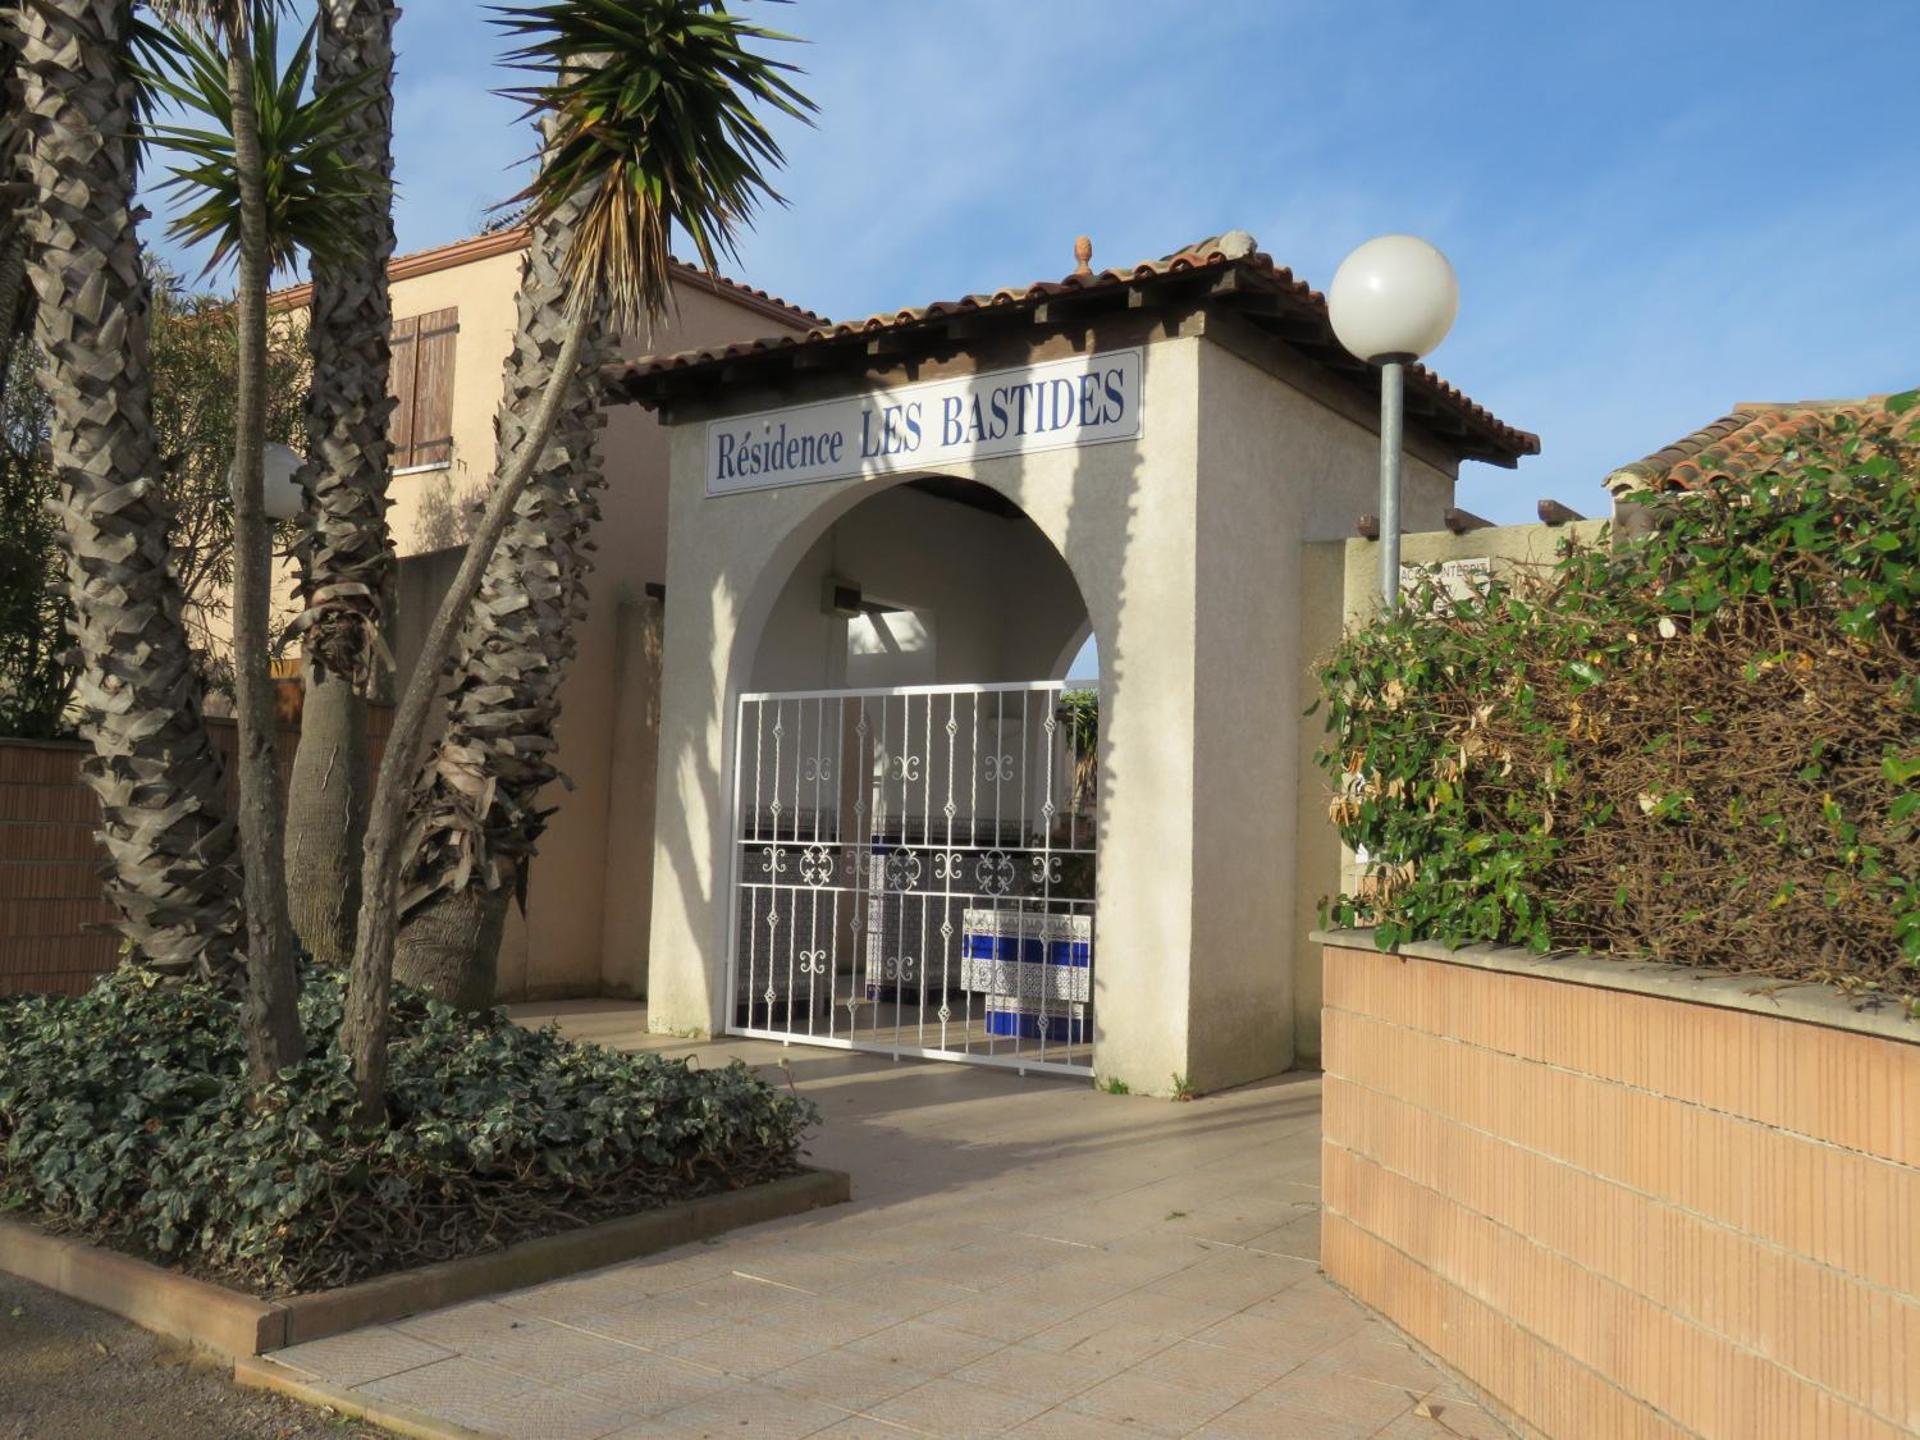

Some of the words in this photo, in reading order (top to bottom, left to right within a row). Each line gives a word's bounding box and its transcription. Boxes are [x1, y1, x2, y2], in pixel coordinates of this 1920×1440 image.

[716, 424, 844, 480] Résidence
[860, 402, 922, 459] LES
[941, 368, 1125, 447] BASTIDES
